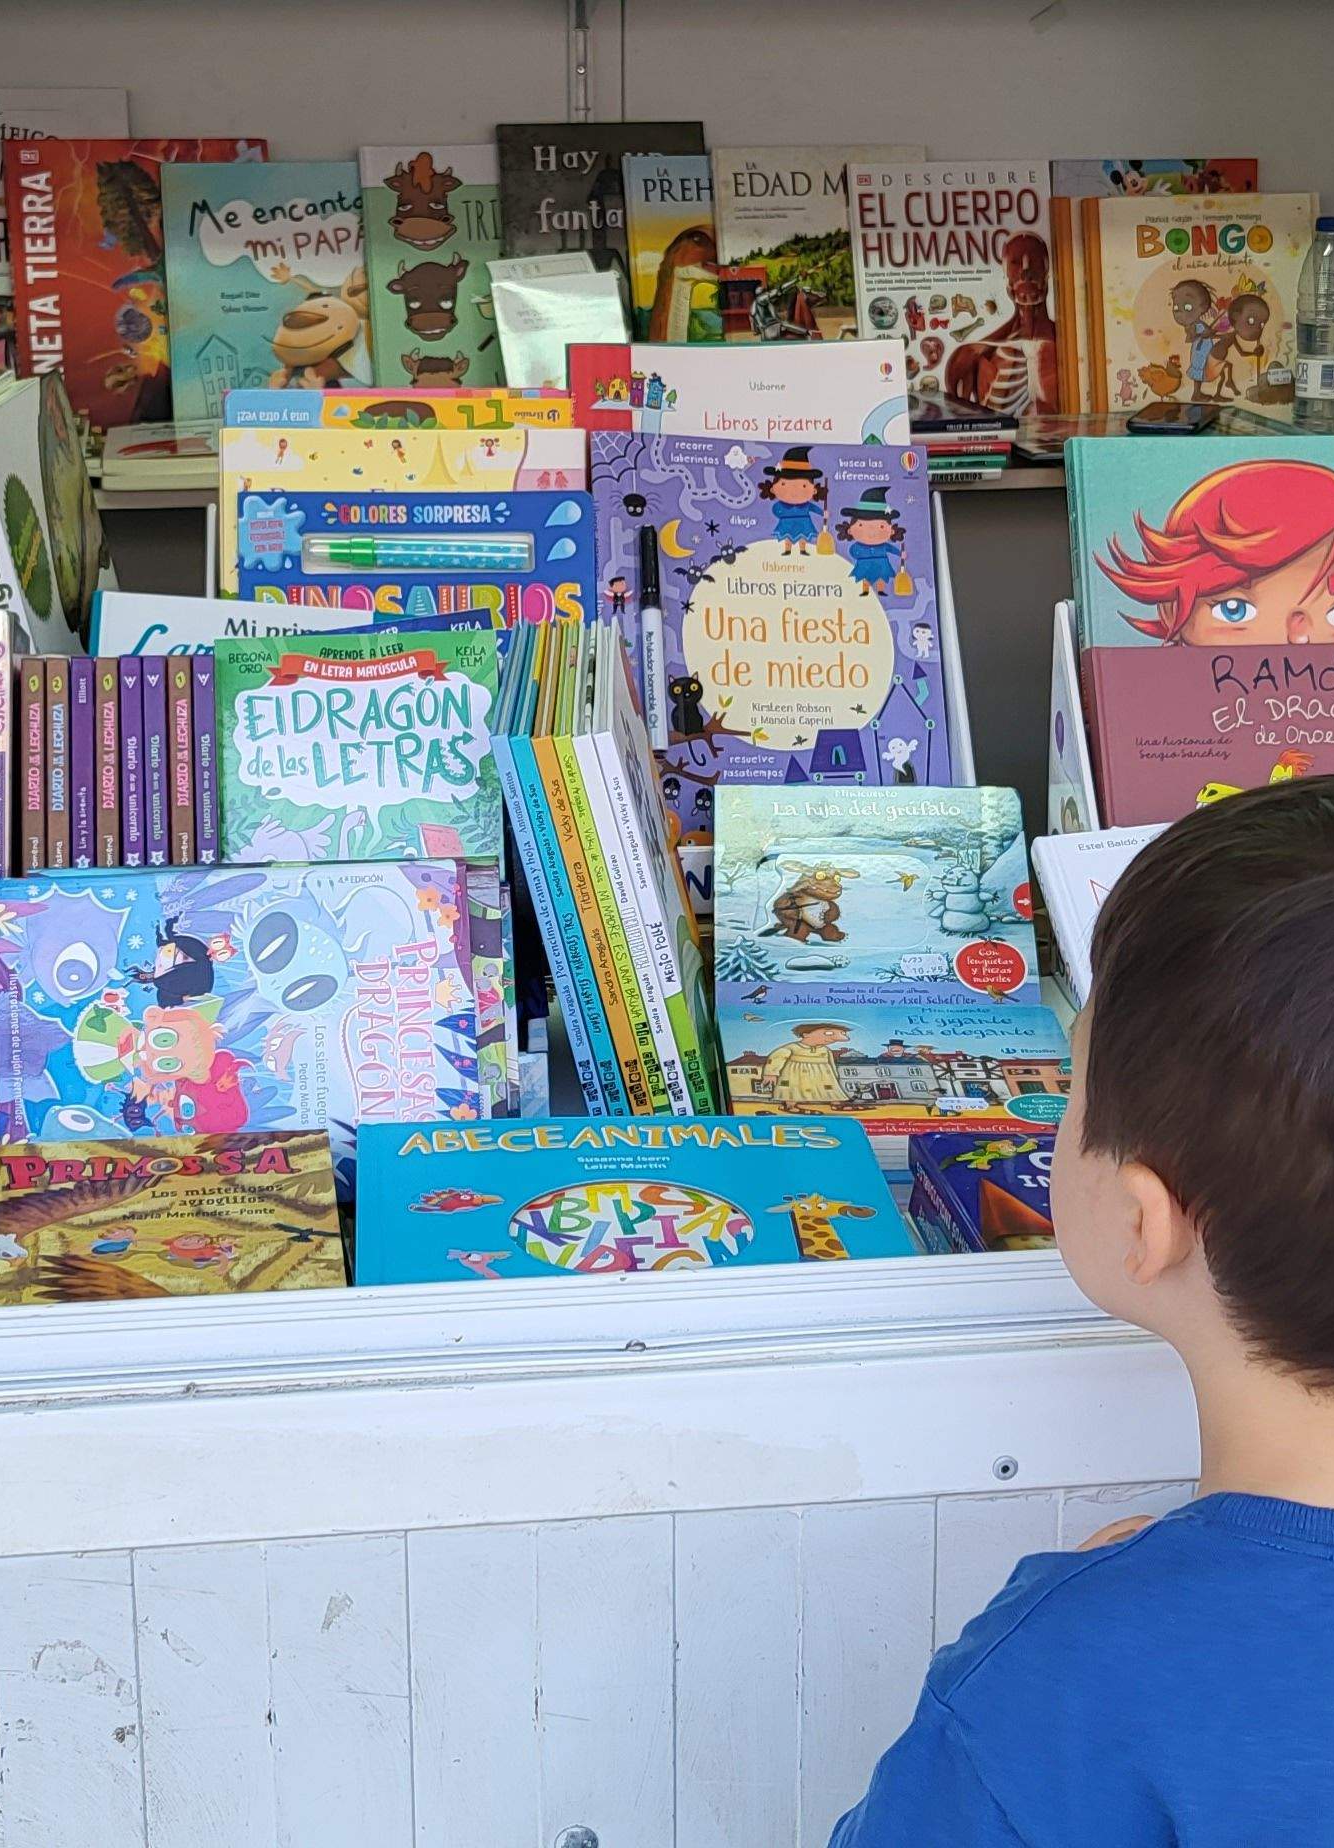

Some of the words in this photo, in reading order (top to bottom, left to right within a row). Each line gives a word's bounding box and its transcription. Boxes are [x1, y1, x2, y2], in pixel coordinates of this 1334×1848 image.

[533, 145, 599, 176] Hay
[656, 168, 669, 177] LA
[732, 171, 812, 197] EDAD
[881, 171, 1037, 186] DESCUBRE
[189, 199, 242, 238] Me
[858, 192, 896, 228] EL
[904, 188, 1039, 227] CUERPO
[23, 170, 59, 284] TIERRA
[244, 236, 286, 261] mi
[1136, 223, 1274, 259] BONGO
[749, 381, 787, 392] Usborne
[704, 411, 759, 433] Libros
[766, 412, 834, 446] pizarra
[339, 504, 407, 523] COLORES
[413, 504, 491, 524] SORPRESA
[762, 562, 805, 572] Usborne
[727, 579, 776, 597] Libros
[783, 581, 843, 604] pizarra
[705, 610, 767, 642] Una
[782, 608, 870, 644] fiesta
[228, 651, 272, 664] BEGOÑA
[319, 645, 367, 661] APRENDE
[379, 642, 404, 657] LEER
[460, 655, 484, 668] ELM
[238, 662, 263, 674] ORO
[304, 664, 318, 677] EN
[320, 662, 353, 678] LETRA
[356, 657, 417, 677] MAYÚSCULA
[711, 649, 752, 688] de
[767, 650, 869, 689] miedo
[290, 680, 472, 739] DRAGÓN
[796, 702, 832, 714] Robson
[1253, 728, 1282, 746] de
[247, 751, 276, 779] de
[279, 750, 309, 776] las
[313, 731, 477, 793] LETRAS
[772, 803, 799, 817] La
[397, 1124, 844, 1158] ABECEANIMALES
[150, 1189, 178, 1199] Los
